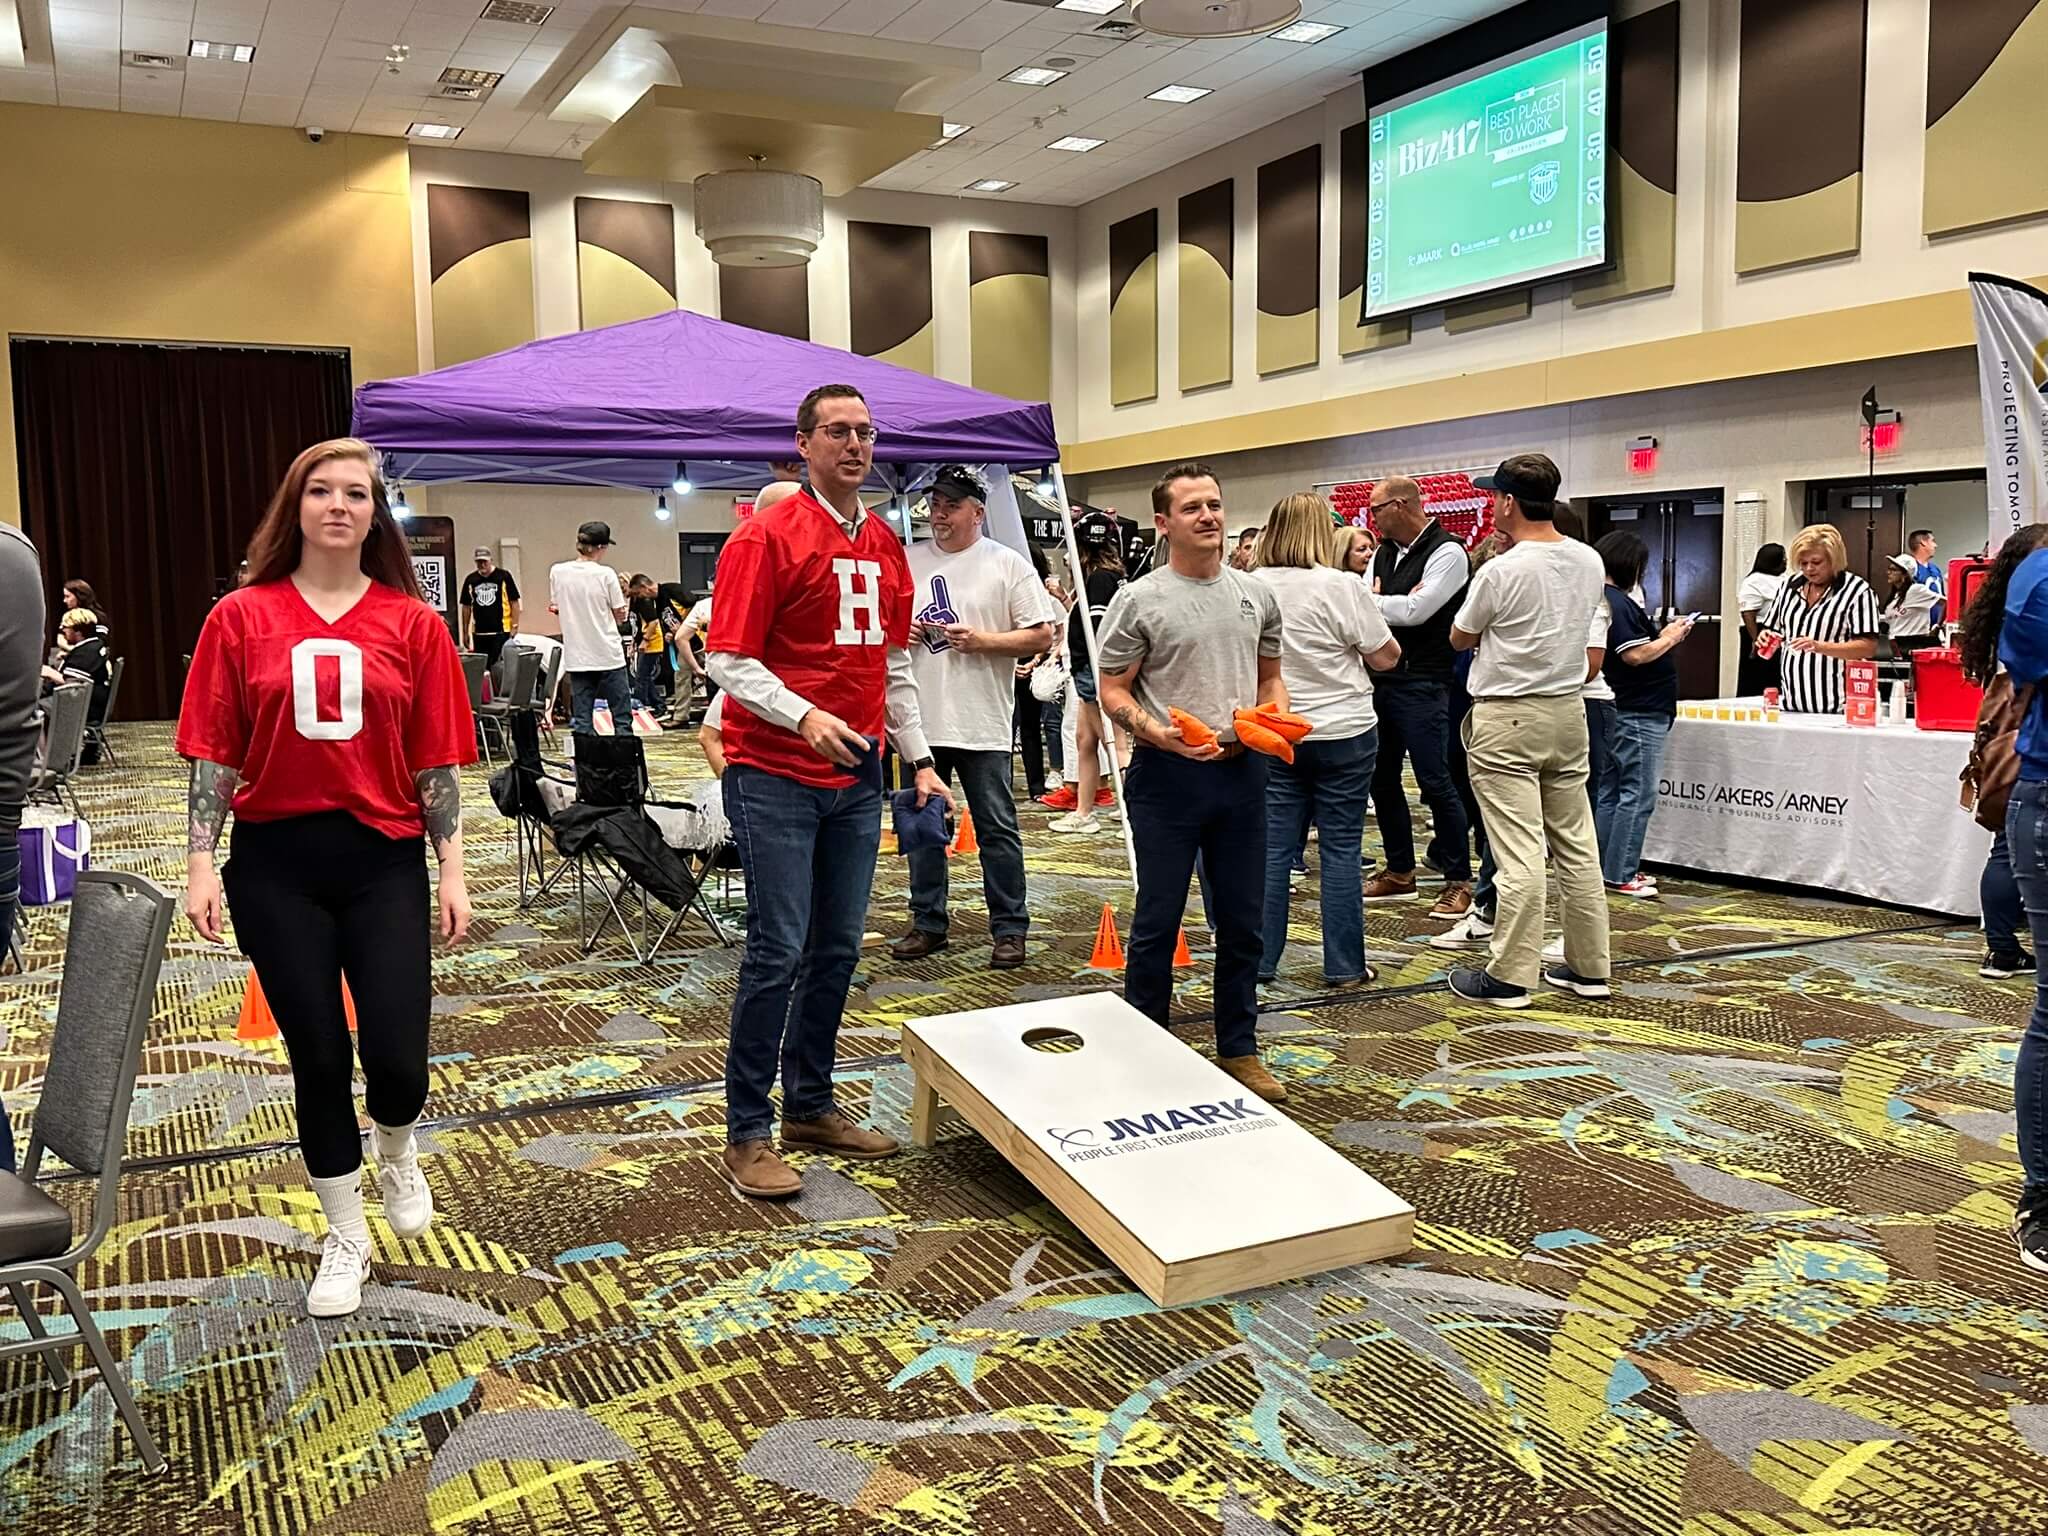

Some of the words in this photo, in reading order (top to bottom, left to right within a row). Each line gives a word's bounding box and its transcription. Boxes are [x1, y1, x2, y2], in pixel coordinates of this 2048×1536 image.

[1588, 44, 1604, 75] 50
[1489, 107, 1517, 131] BEST
[1518, 93, 1561, 121] PLACES
[1587, 87, 1602, 117] 40
[1372, 120, 1384, 143] 10
[1497, 126, 1514, 145] TO
[1515, 114, 1552, 140] WORK
[1398, 117, 1482, 177] Biz417
[1587, 131, 1602, 161] 30
[1371, 160, 1384, 184] 20
[1587, 176, 1601, 205] 20
[1371, 197, 1384, 223] 30
[1370, 235, 1383, 261] 40
[1586, 224, 1601, 251] 10
[1370, 272, 1382, 297] 50
[2001, 360, 2019, 466] PROTECTING
[1033, 519, 1048, 537] THE
[832, 557, 885, 646] H
[1787, 816, 1844, 828] ADVISORS
[1102, 1098, 1266, 1142] JMARK
[1067, 1146, 1119, 1163] PEOPLE
[1117, 1140, 1156, 1156] FIRST.
[1152, 1126, 1231, 1148] TECHNOLOGY
[1229, 1117, 1280, 1134] SECOND.
